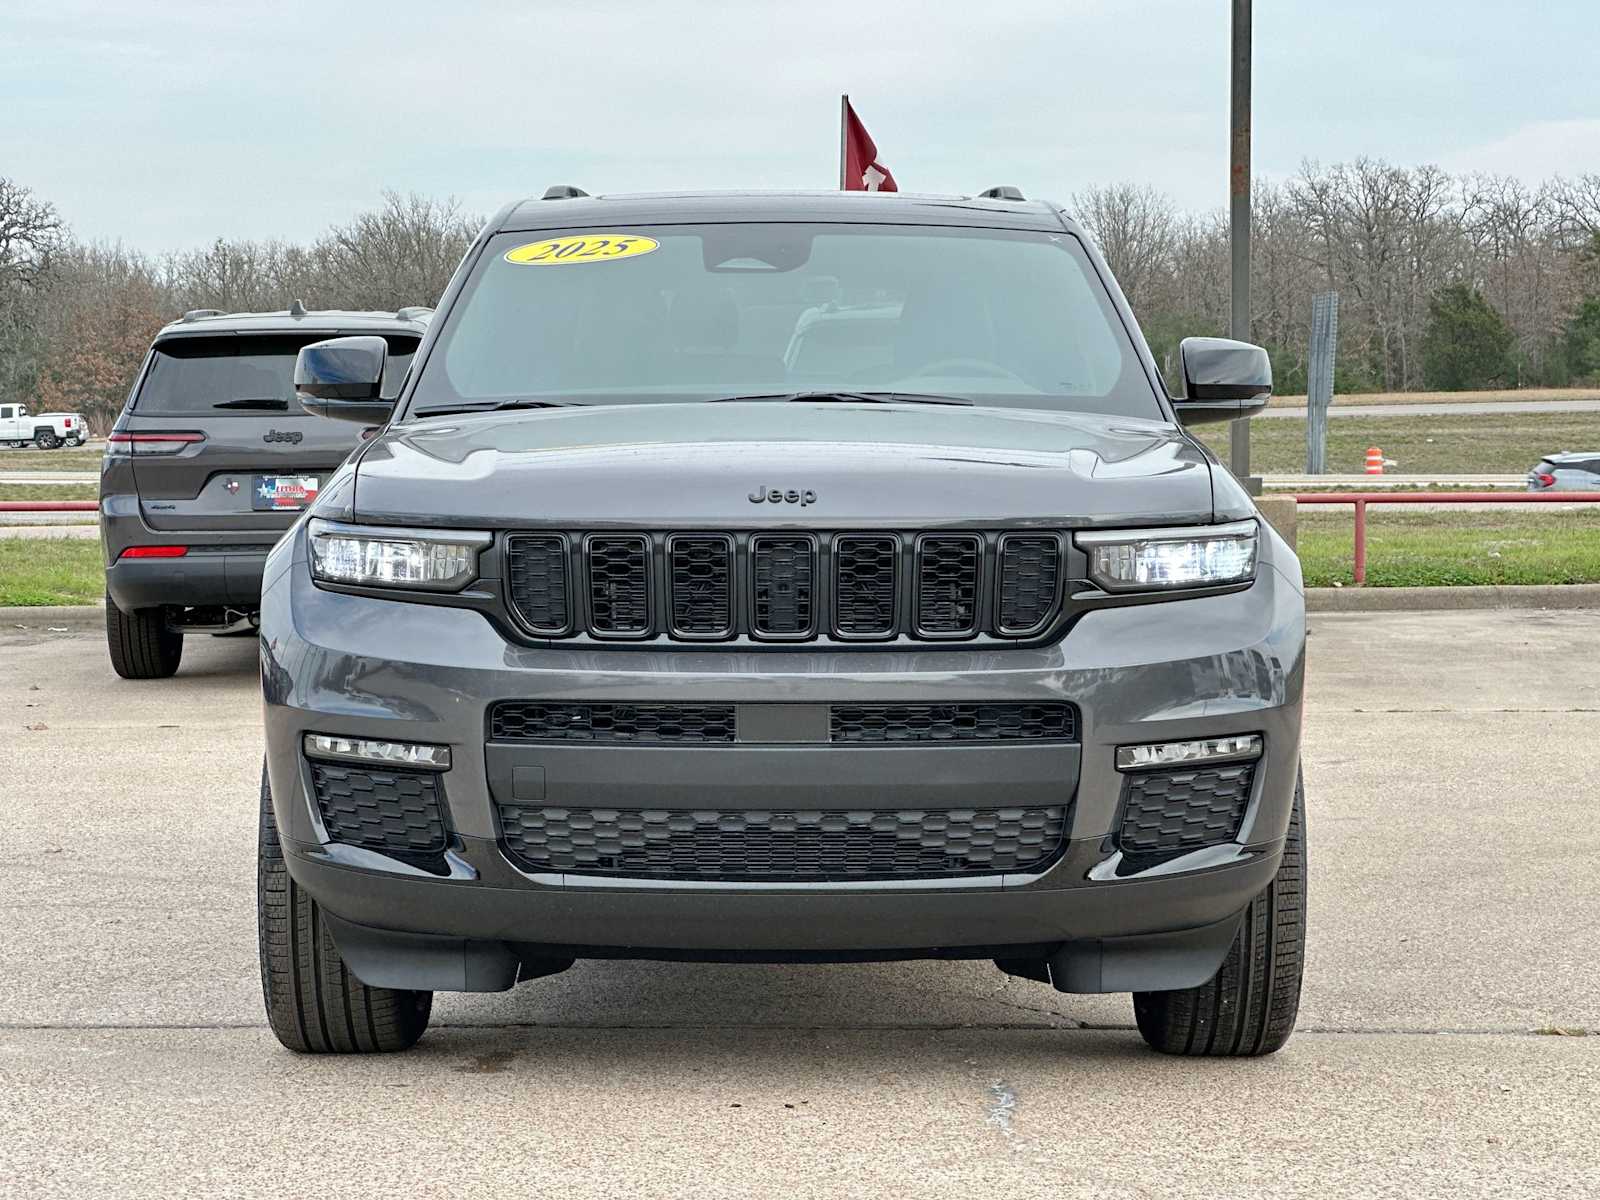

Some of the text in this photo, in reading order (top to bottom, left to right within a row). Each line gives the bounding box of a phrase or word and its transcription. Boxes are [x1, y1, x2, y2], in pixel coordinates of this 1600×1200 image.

[527, 239, 638, 261] 2025
[263, 429, 303, 445] Jeep
[748, 485, 818, 507] Jeep
